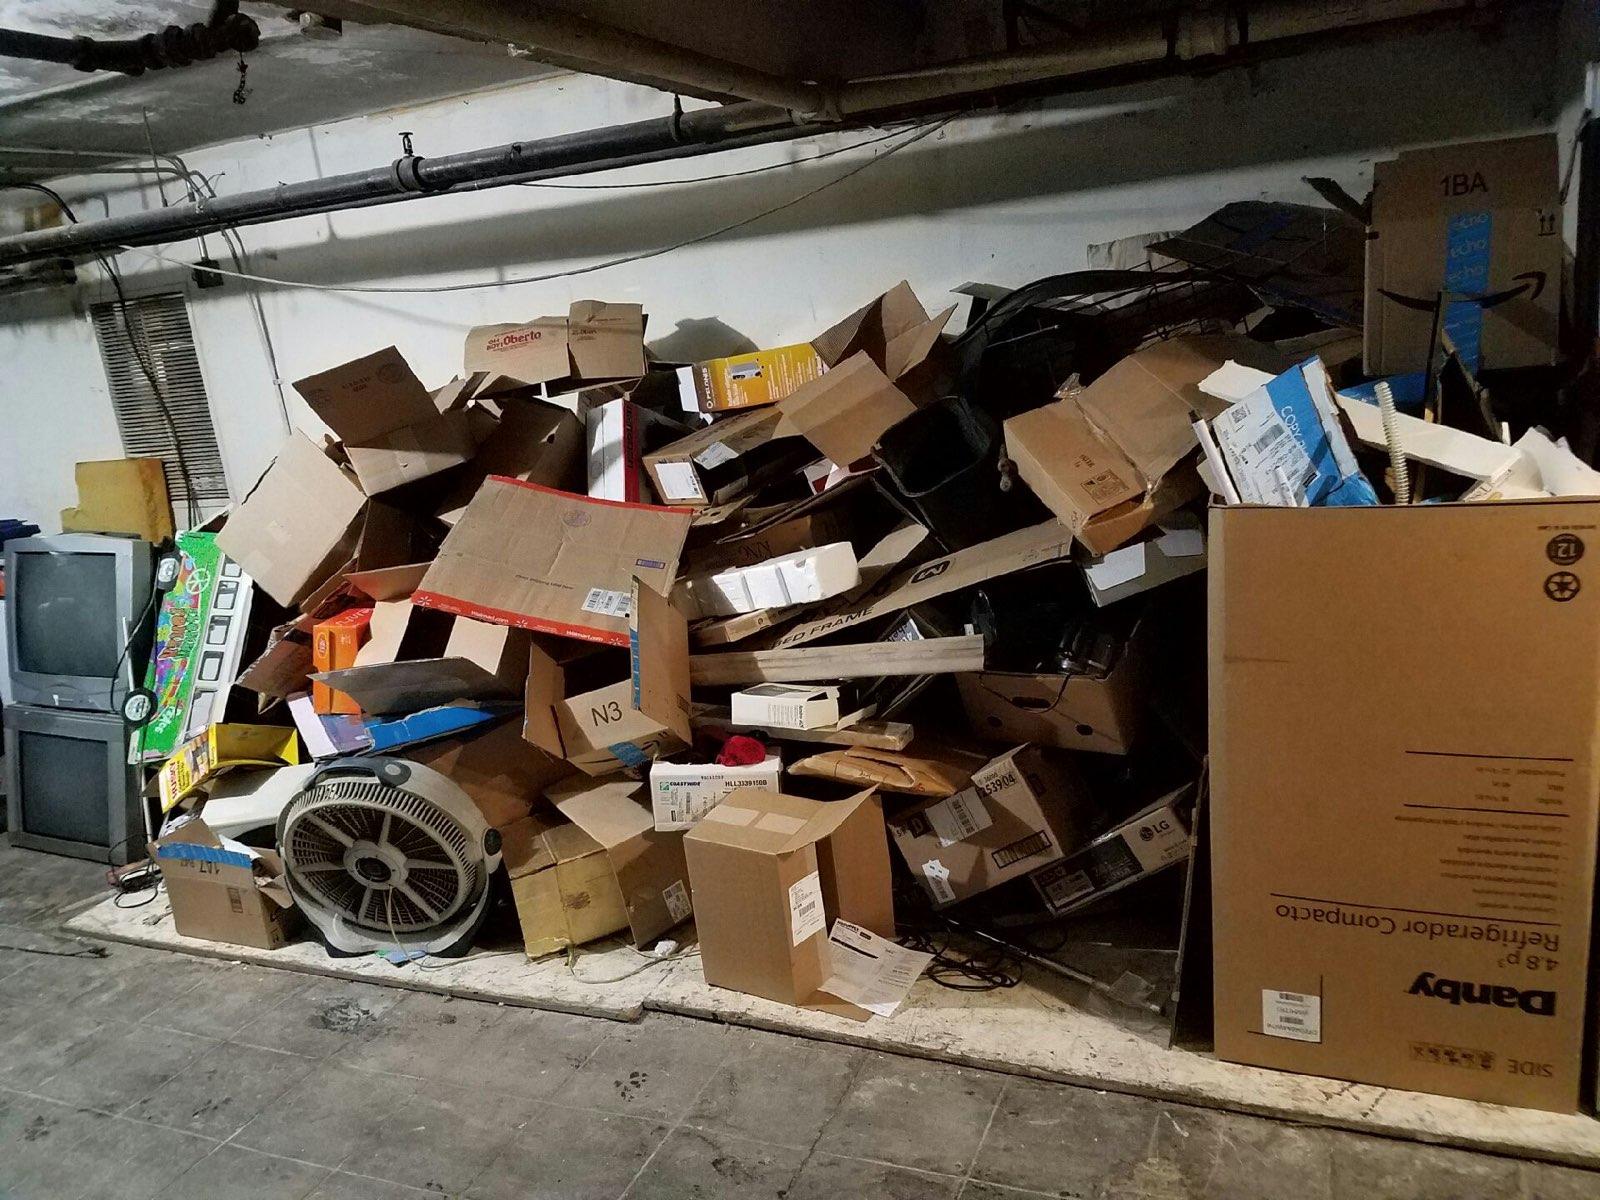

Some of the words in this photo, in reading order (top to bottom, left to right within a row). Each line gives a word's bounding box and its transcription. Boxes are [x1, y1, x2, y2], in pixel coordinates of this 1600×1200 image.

[1440, 172, 1488, 197] 1BA
[503, 330, 542, 346] Oberto
[771, 632, 805, 649] BED
[810, 607, 873, 634] FRAME
[590, 701, 623, 727] N3
[1153, 820, 1170, 834] LG
[1276, 904, 1397, 936] Compacto
[1402, 920, 1560, 951] Refrigerador
[1408, 971, 1556, 1017] Danby
[1507, 1058, 1554, 1078] SIDE
